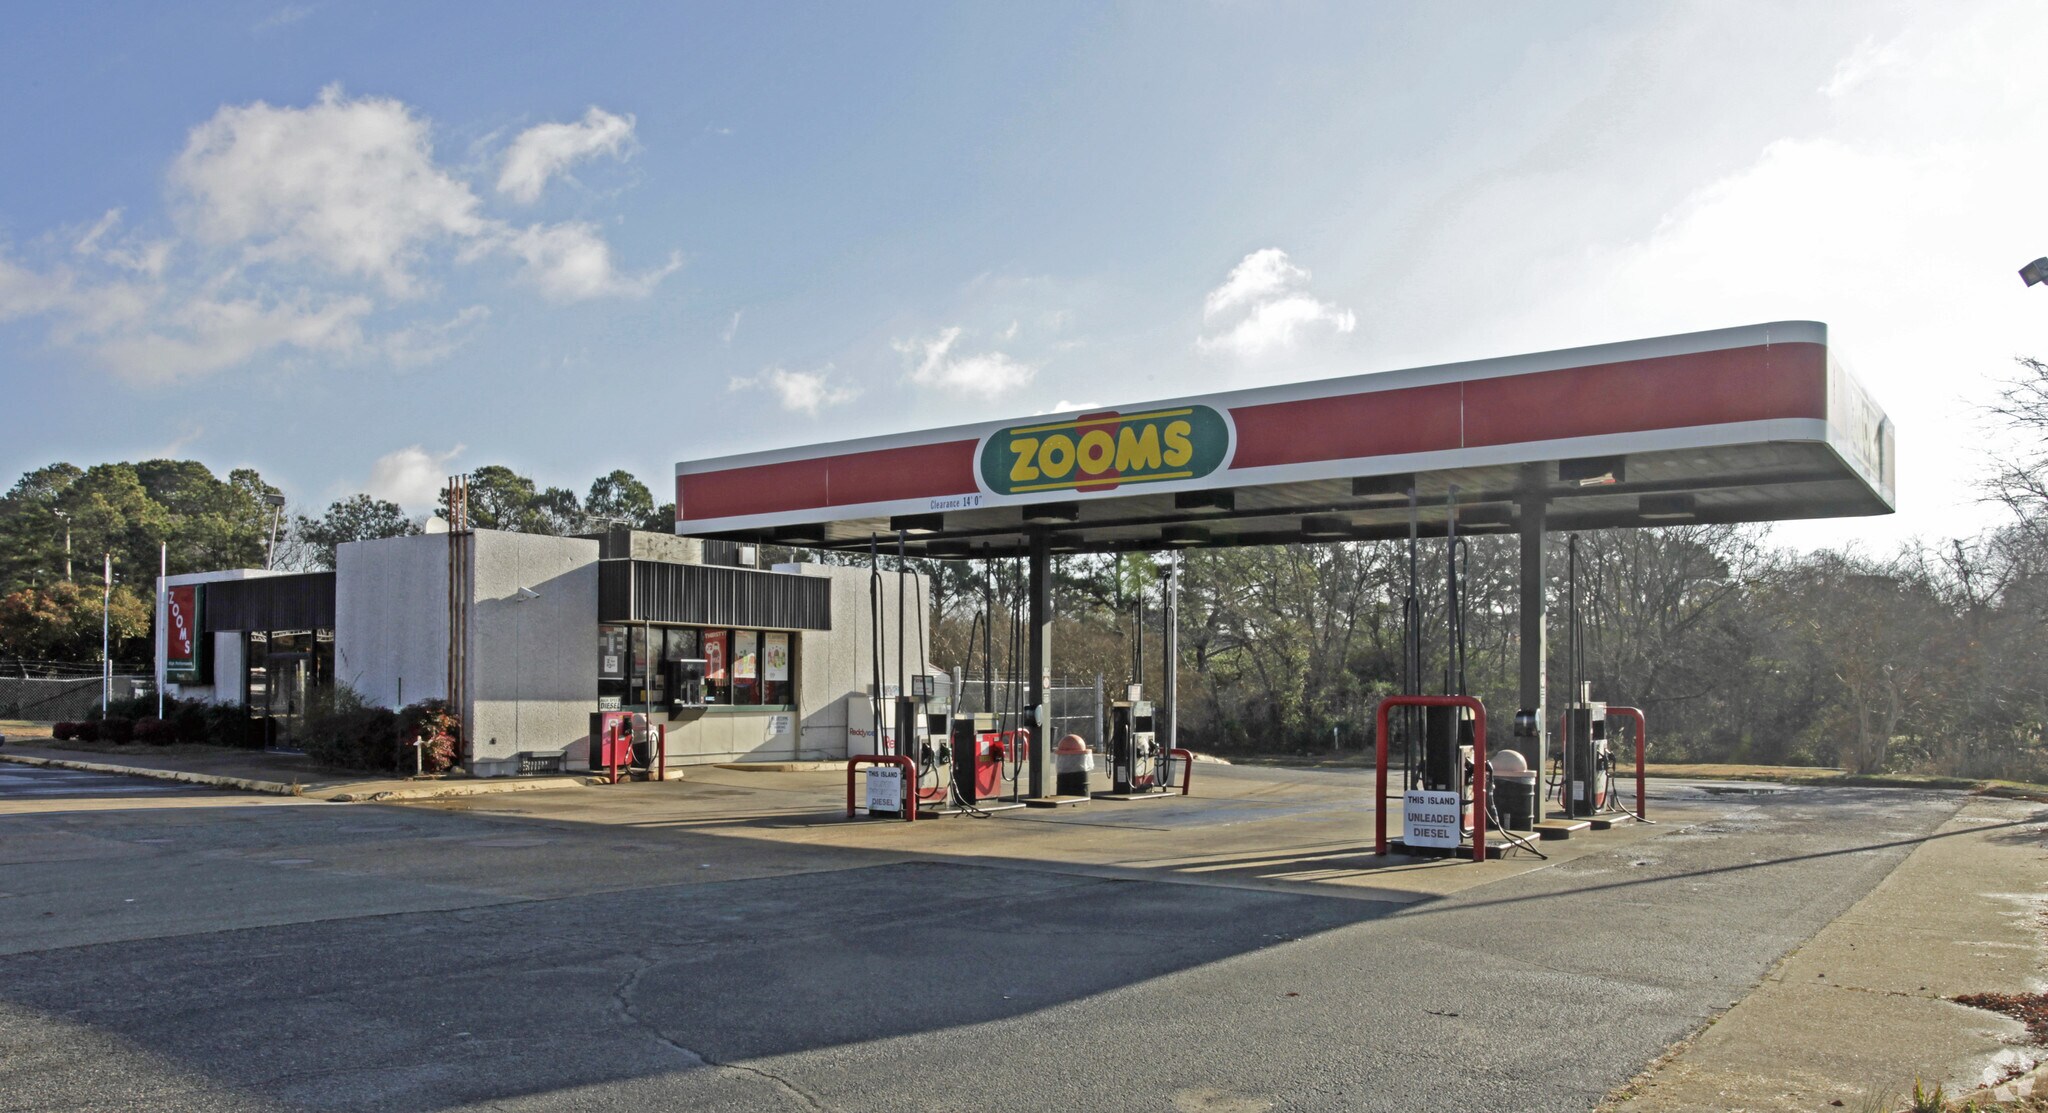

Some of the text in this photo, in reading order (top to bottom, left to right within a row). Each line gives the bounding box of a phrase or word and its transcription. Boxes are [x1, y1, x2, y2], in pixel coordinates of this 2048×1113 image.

[1009, 420, 1193, 482] ZOOMS
[930, 499, 960, 510] Clearance
[169, 591, 190, 654] ZOOMS
[600, 702, 621, 710] DIESEL
[871, 798, 894, 806] DIESEL
[1408, 796, 1455, 805] THIS ISLAND
[1407, 812, 1456, 824] UNLEADED
[1413, 828, 1450, 839] DIESEL
